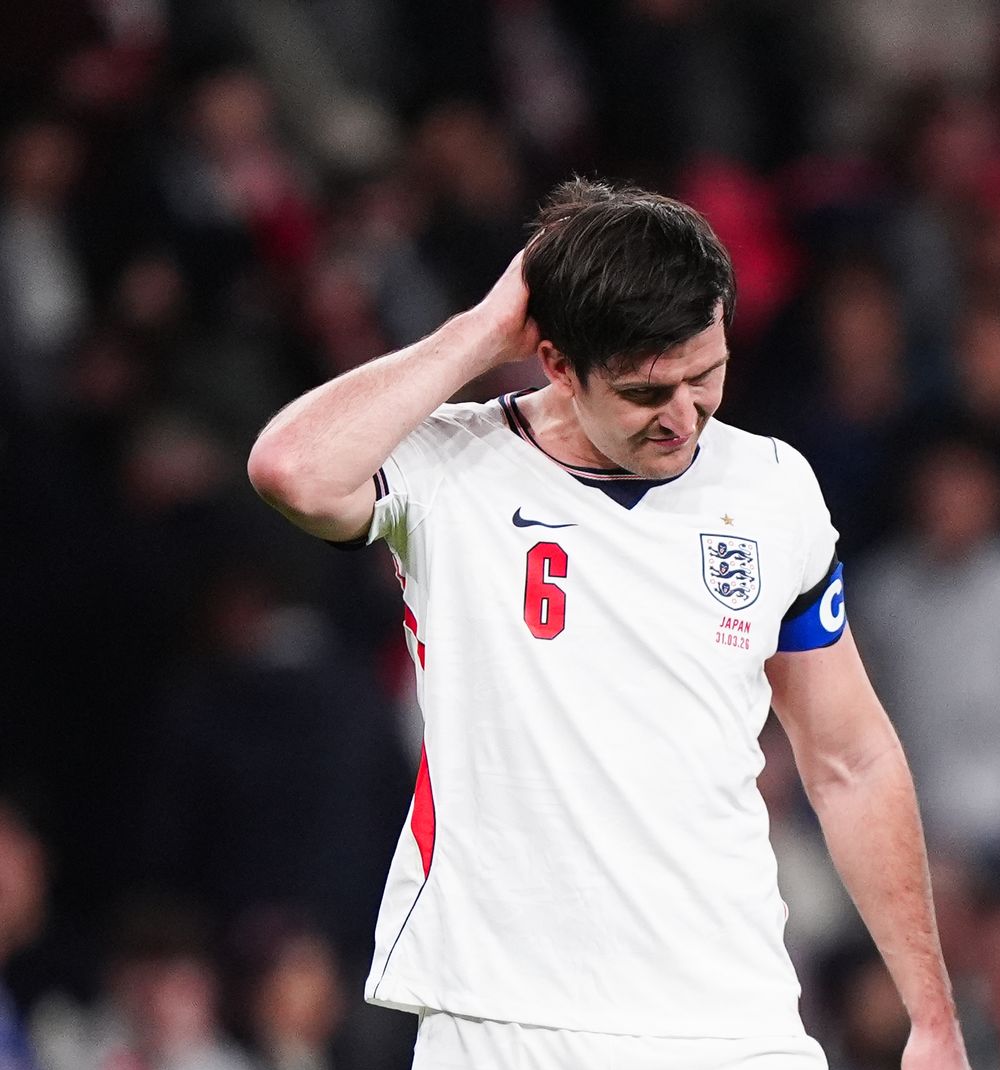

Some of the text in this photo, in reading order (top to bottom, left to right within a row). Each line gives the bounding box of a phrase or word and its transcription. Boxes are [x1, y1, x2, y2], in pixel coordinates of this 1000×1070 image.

[523, 541, 568, 640] 6
[819, 578, 845, 632] C
[715, 631, 750, 650] 31.03.26
[720, 616, 751, 634] JAPAN
